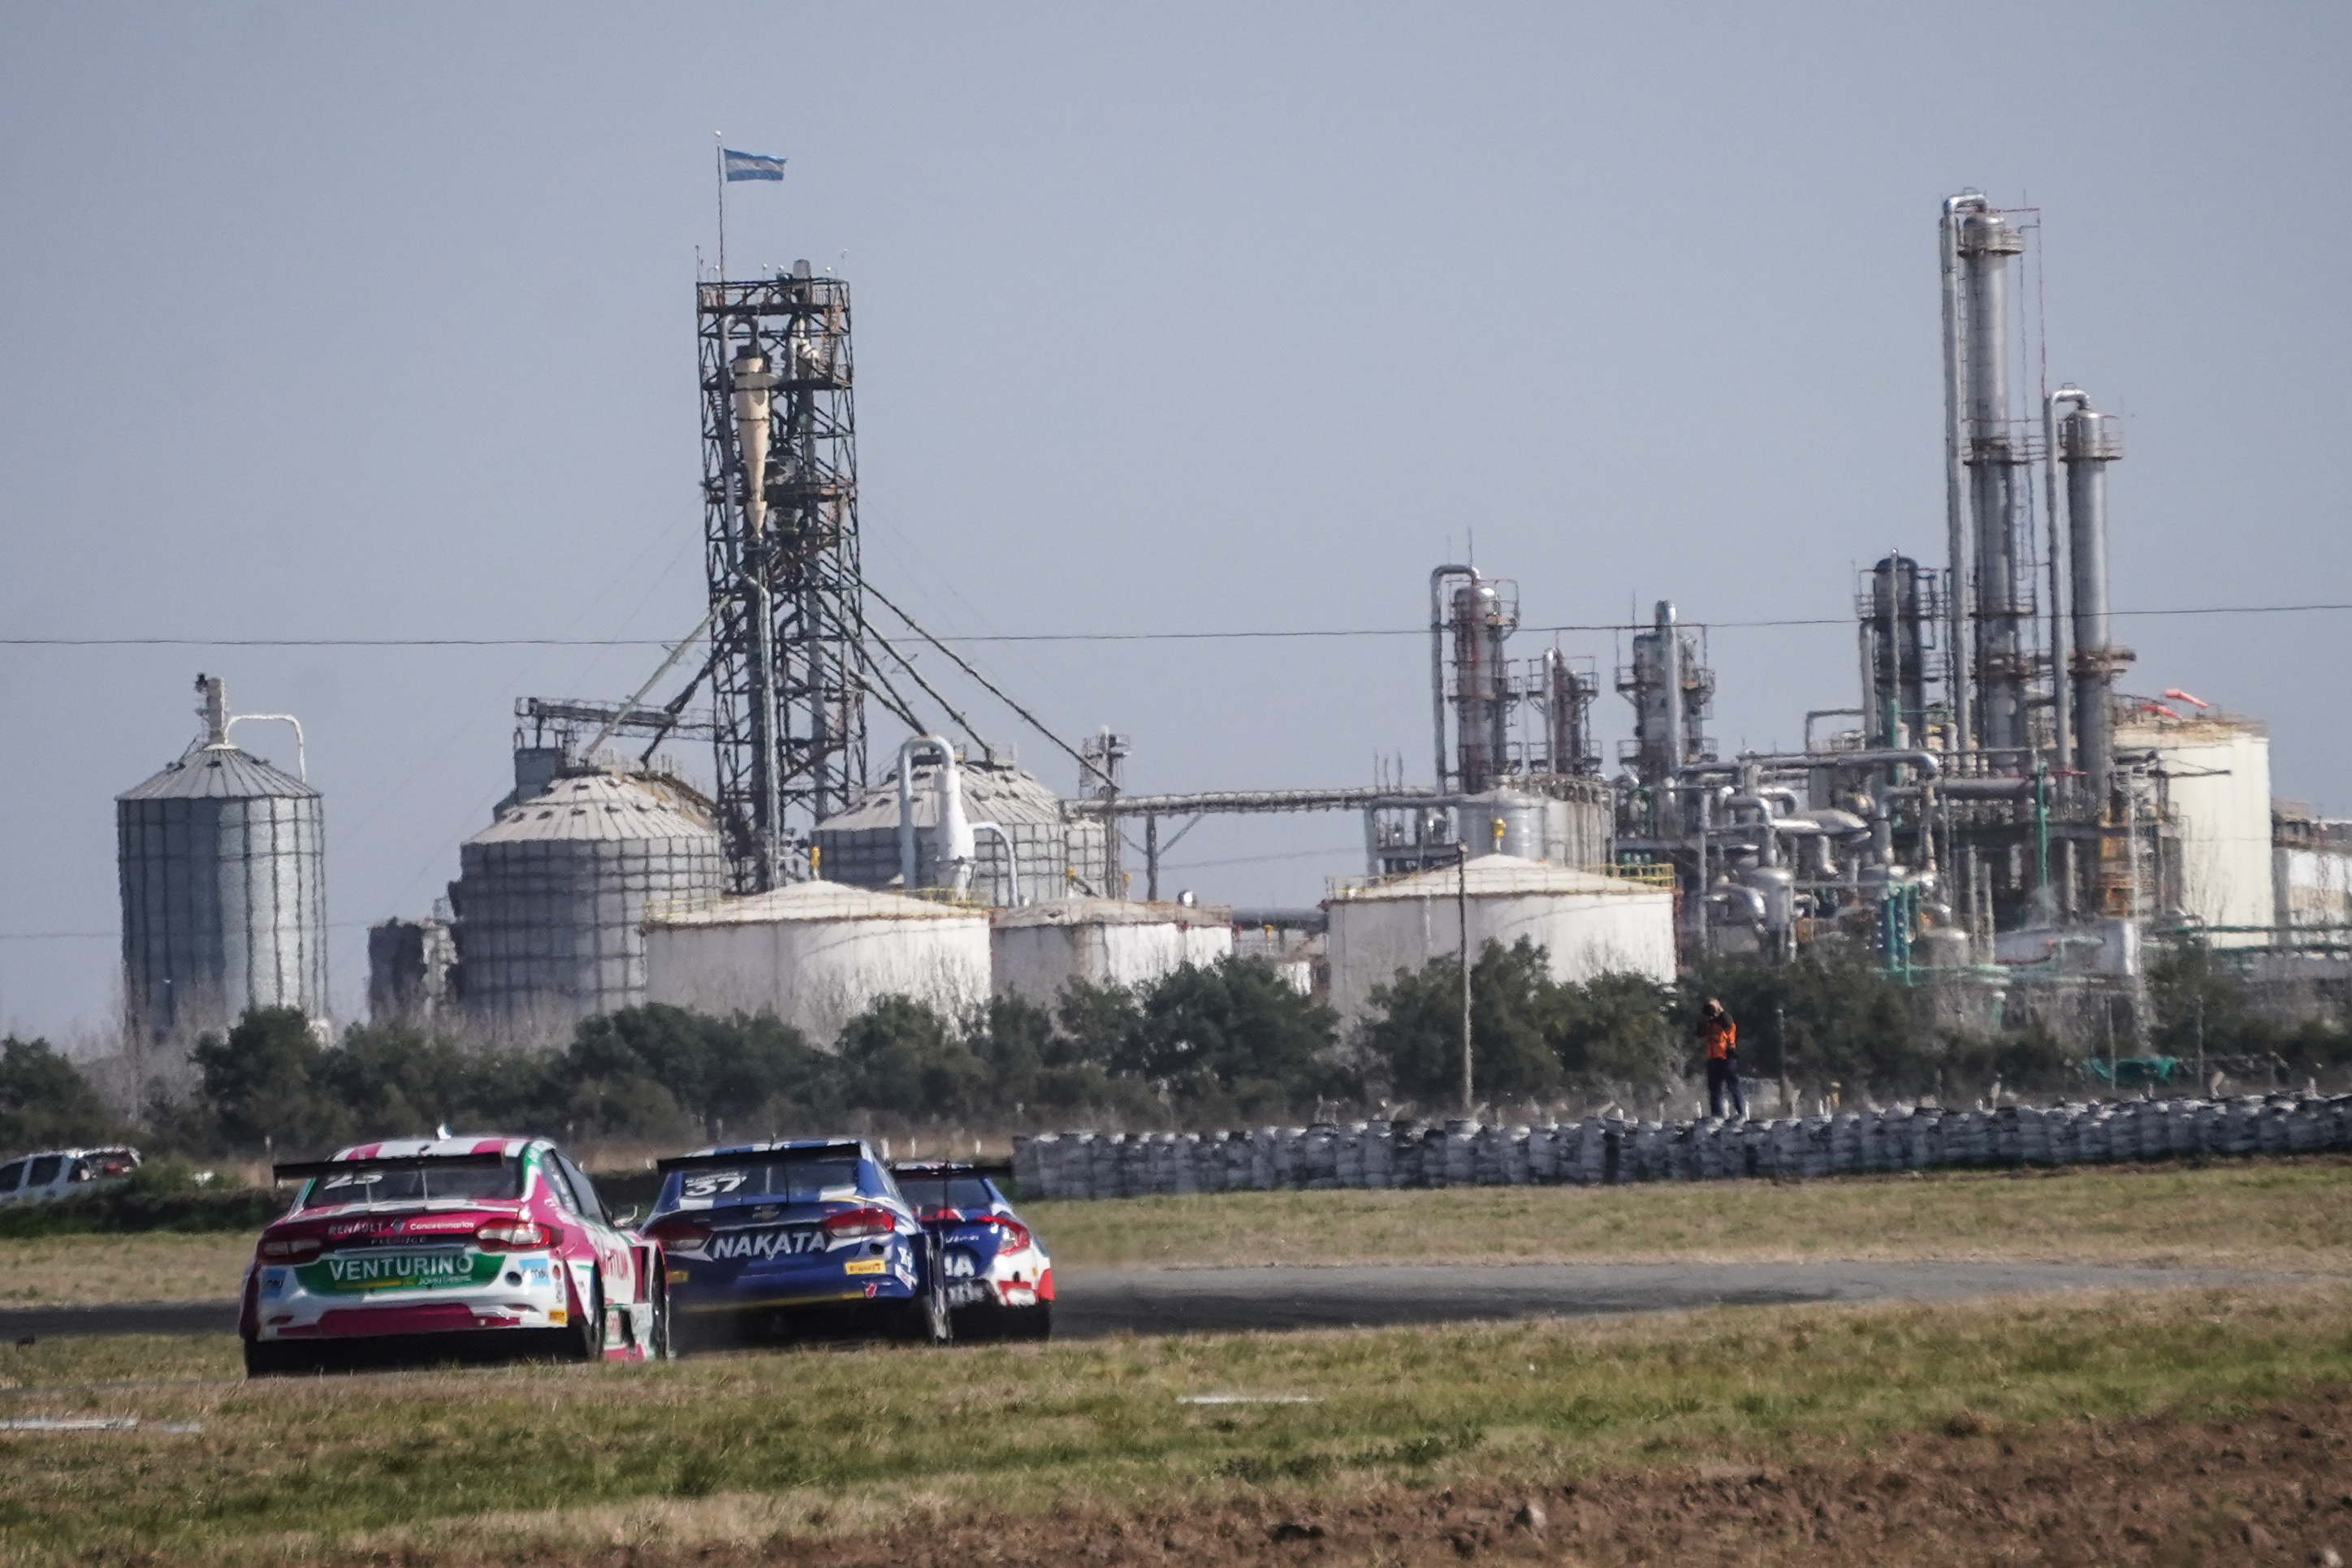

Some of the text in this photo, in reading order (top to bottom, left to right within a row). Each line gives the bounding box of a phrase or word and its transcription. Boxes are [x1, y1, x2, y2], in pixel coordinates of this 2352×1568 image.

[685, 1177, 748, 1196] 37
[713, 1231, 827, 1259] NAKATA
[329, 1255, 474, 1281] VENTURINO
